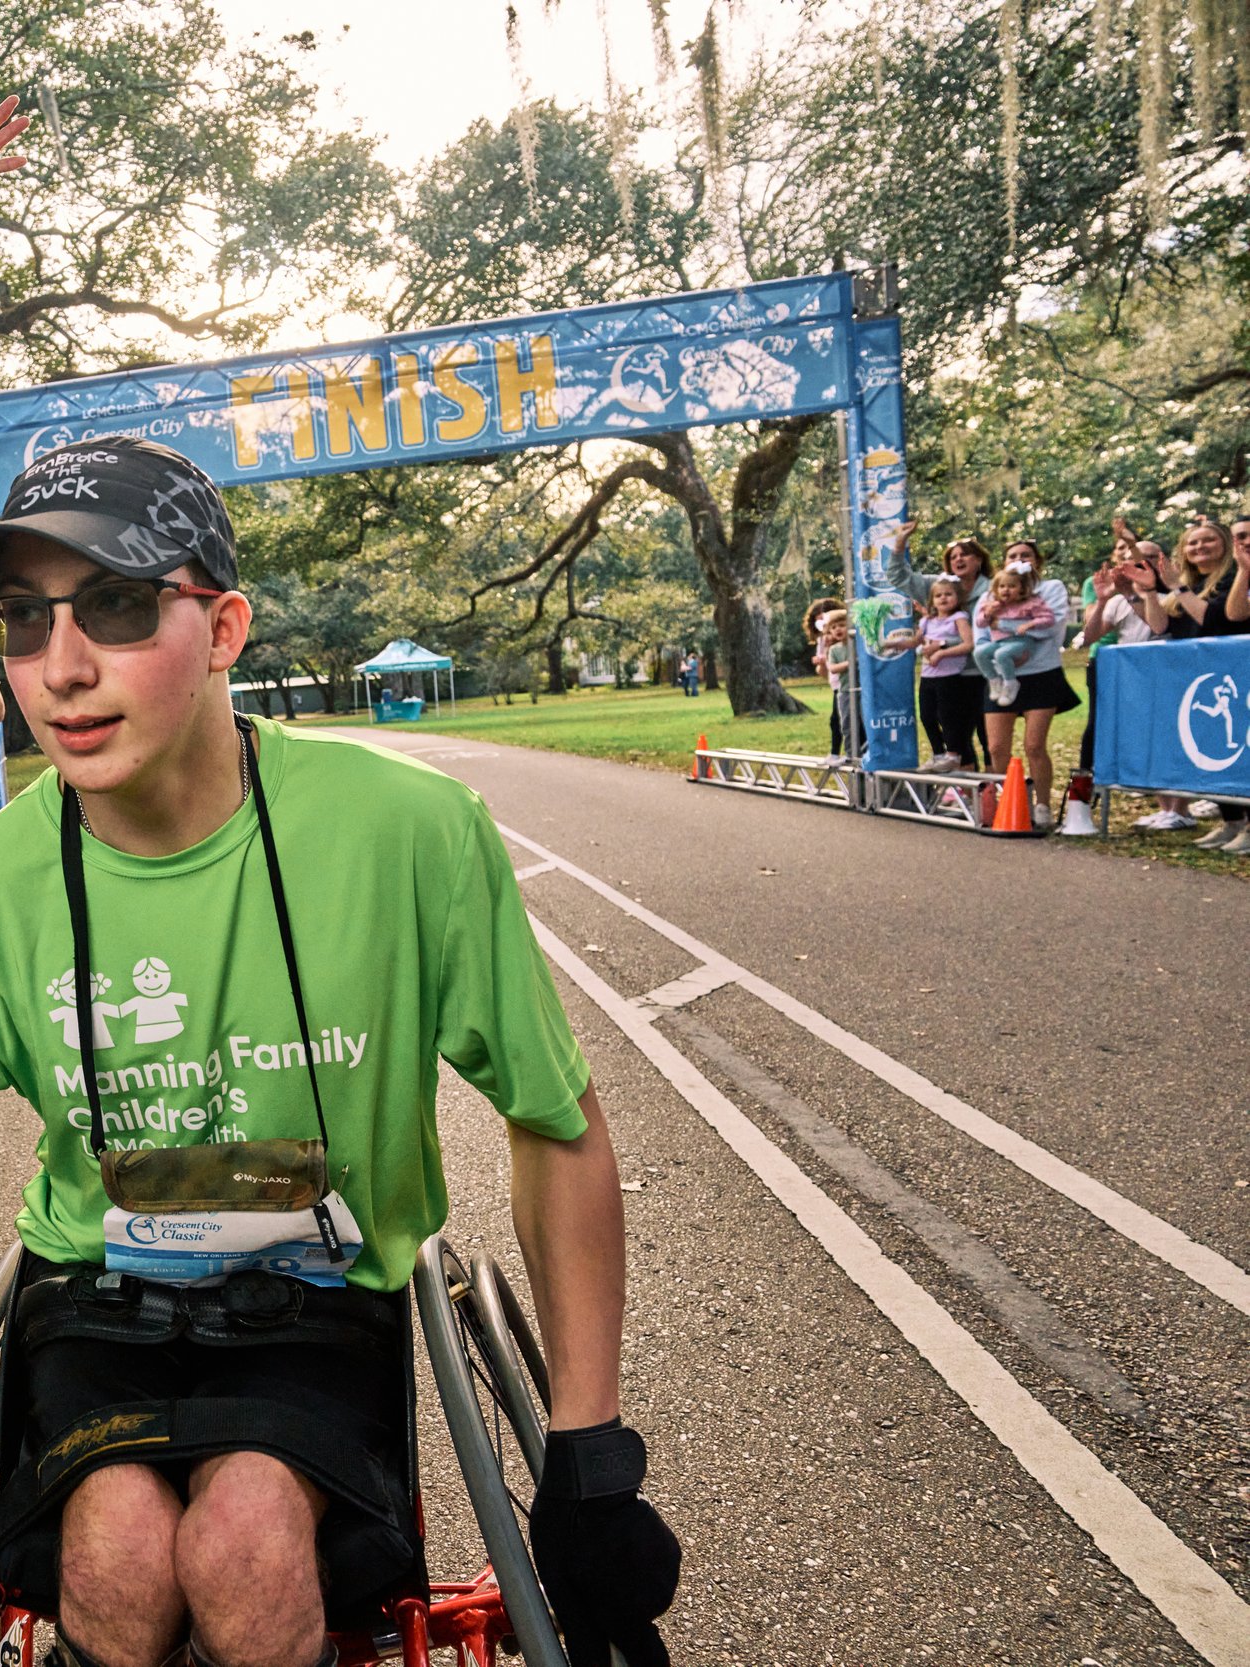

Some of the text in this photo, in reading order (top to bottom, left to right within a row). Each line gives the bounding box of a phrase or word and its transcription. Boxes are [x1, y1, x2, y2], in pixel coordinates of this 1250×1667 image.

[758, 335, 798, 356] City
[230, 333, 560, 468] FINISH
[82, 401, 157, 420] LCMC Health
[150, 417, 185, 437] City
[870, 715, 916, 729] ULTRA
[54, 1026, 367, 1098] Manning Family
[67, 1081, 249, 1134] Children's
[243, 1173, 291, 1185] My-JAXO
[161, 1220, 223, 1232] Crescent City
[161, 1229, 206, 1241] Classic
